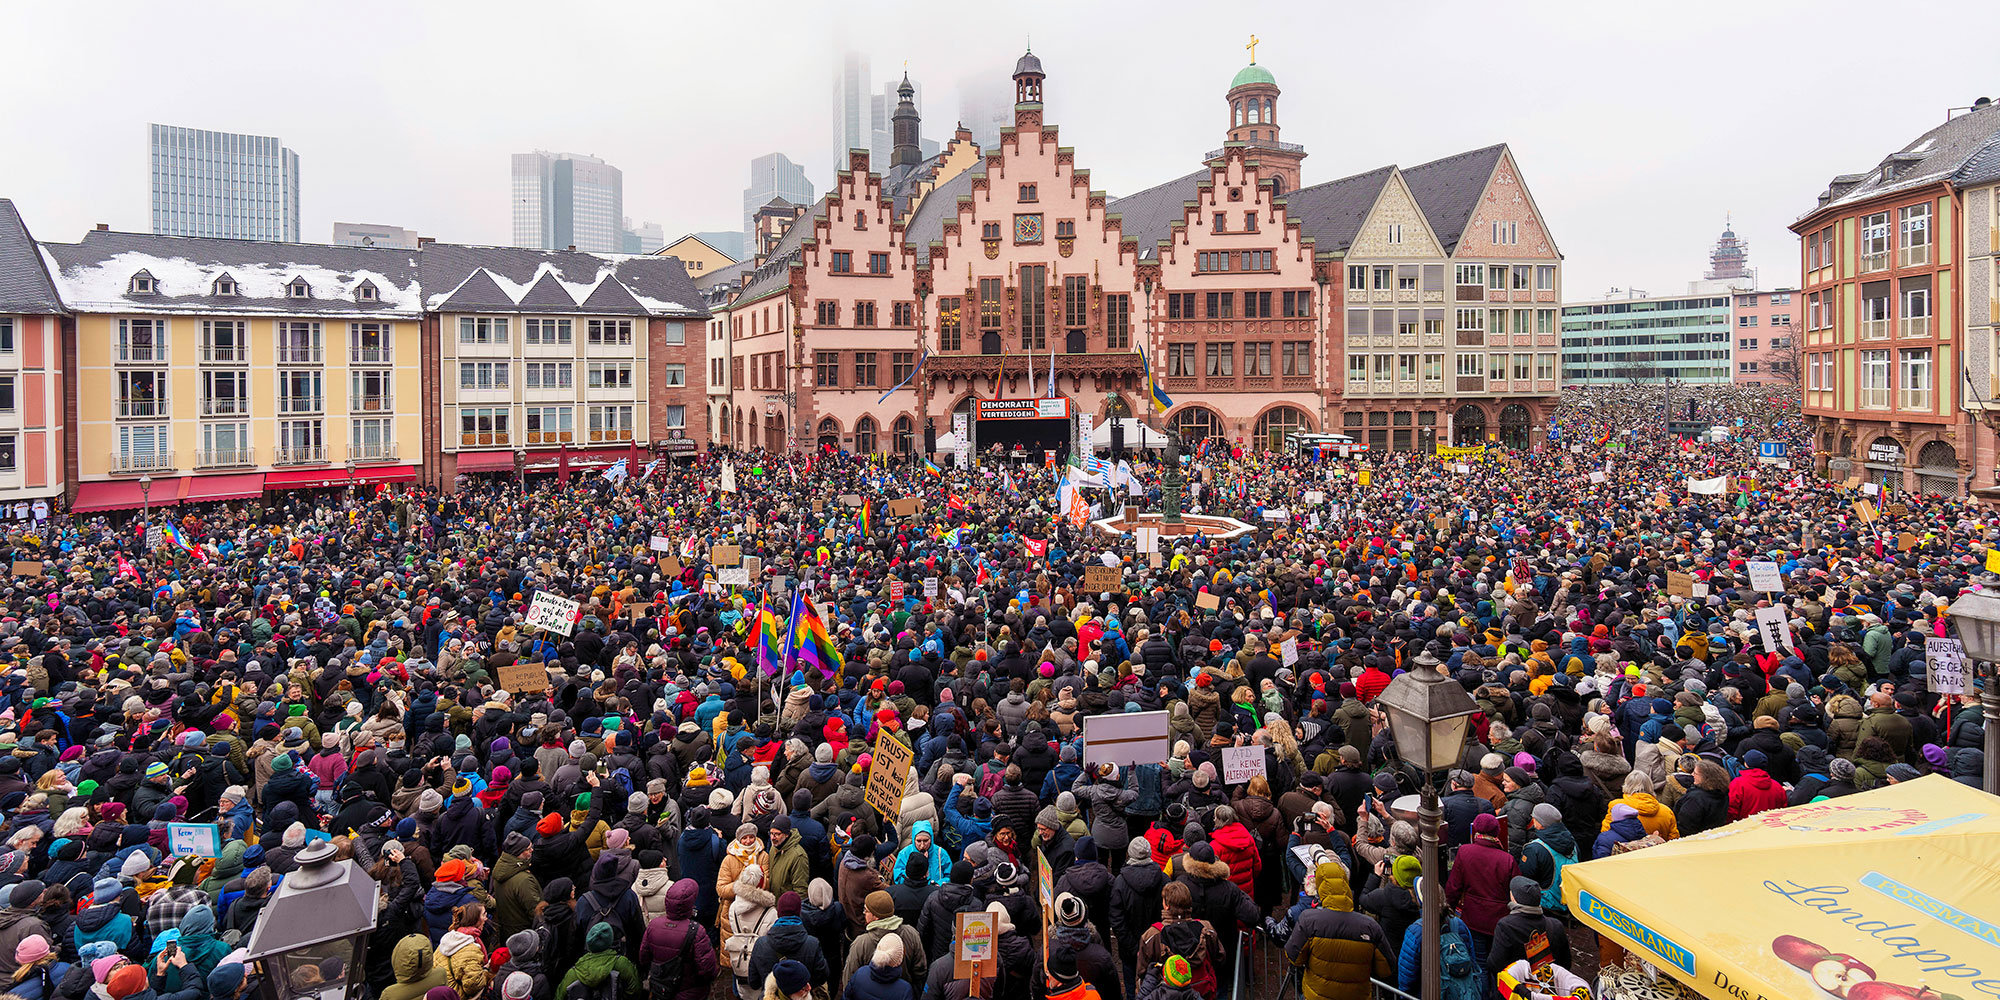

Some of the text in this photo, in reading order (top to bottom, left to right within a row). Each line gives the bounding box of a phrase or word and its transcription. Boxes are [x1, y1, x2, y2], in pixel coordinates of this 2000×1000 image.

[981, 401, 1034, 409] DEMOKRATIE
[981, 410, 1034, 418] VERTEIDIGEN!
[1761, 444, 1774, 456] U
[1776, 444, 1785, 456] U
[1871, 443, 1899, 453] BRILLEN
[535, 592, 573, 610] Demokraten
[543, 606, 564, 618] auf die
[1929, 657, 1970, 674] GEGEN
[508, 679, 546, 689] DEMOCRACY
[1931, 674, 1965, 688] NAZIS
[880, 736, 910, 763] FRUST
[876, 751, 905, 786] IST kein
[1240, 759, 1261, 768] KEINE
[873, 771, 902, 798] GRUND
[866, 791, 876, 805] ZU
[869, 782, 893, 806] NAZIS
[1588, 898, 1686, 968] POSSMANN
